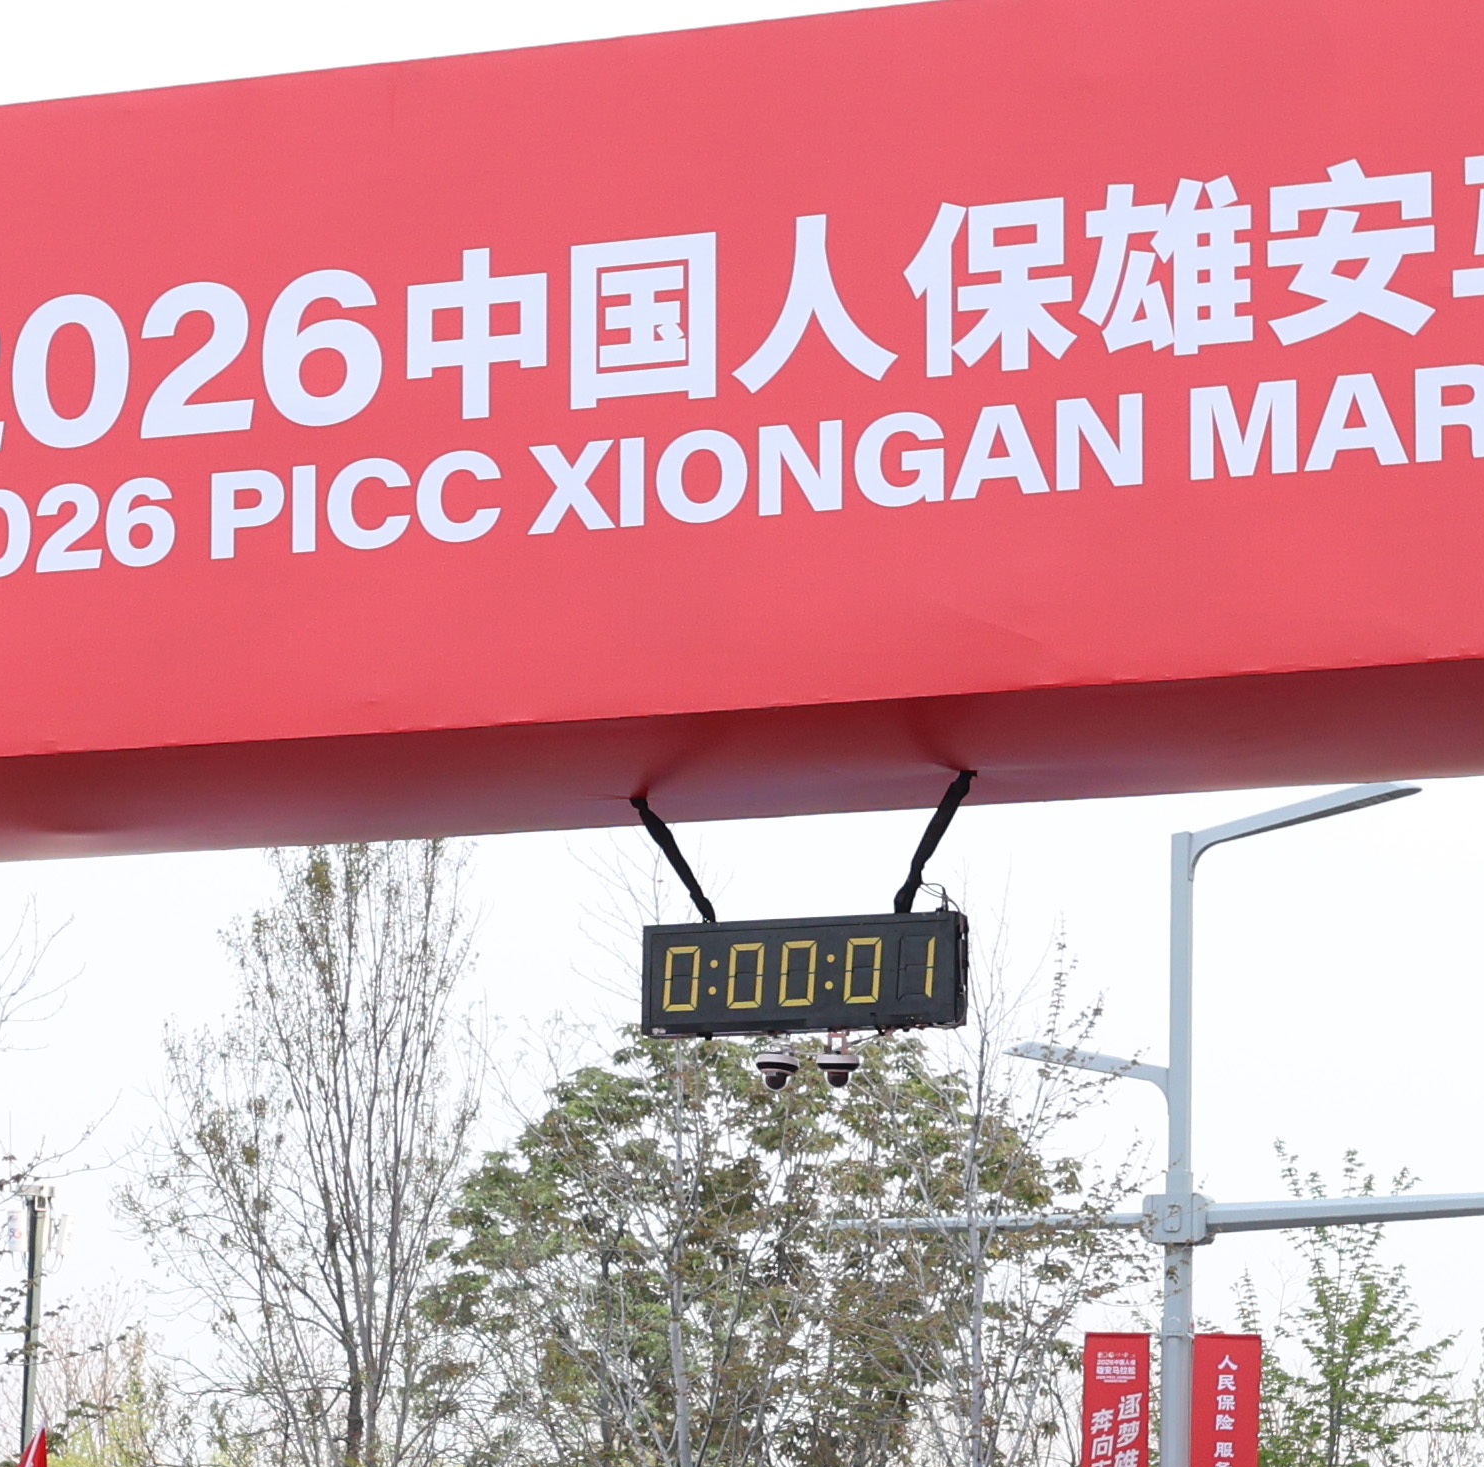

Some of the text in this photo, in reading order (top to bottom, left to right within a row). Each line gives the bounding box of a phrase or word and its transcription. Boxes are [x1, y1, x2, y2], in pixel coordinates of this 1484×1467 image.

[210, 449, 502, 559] PICC
[526, 392, 1144, 535] XIONGAN
[662, 935, 937, 1012] 0:00:01
[1216, 1354, 1239, 1432] 人民保险
